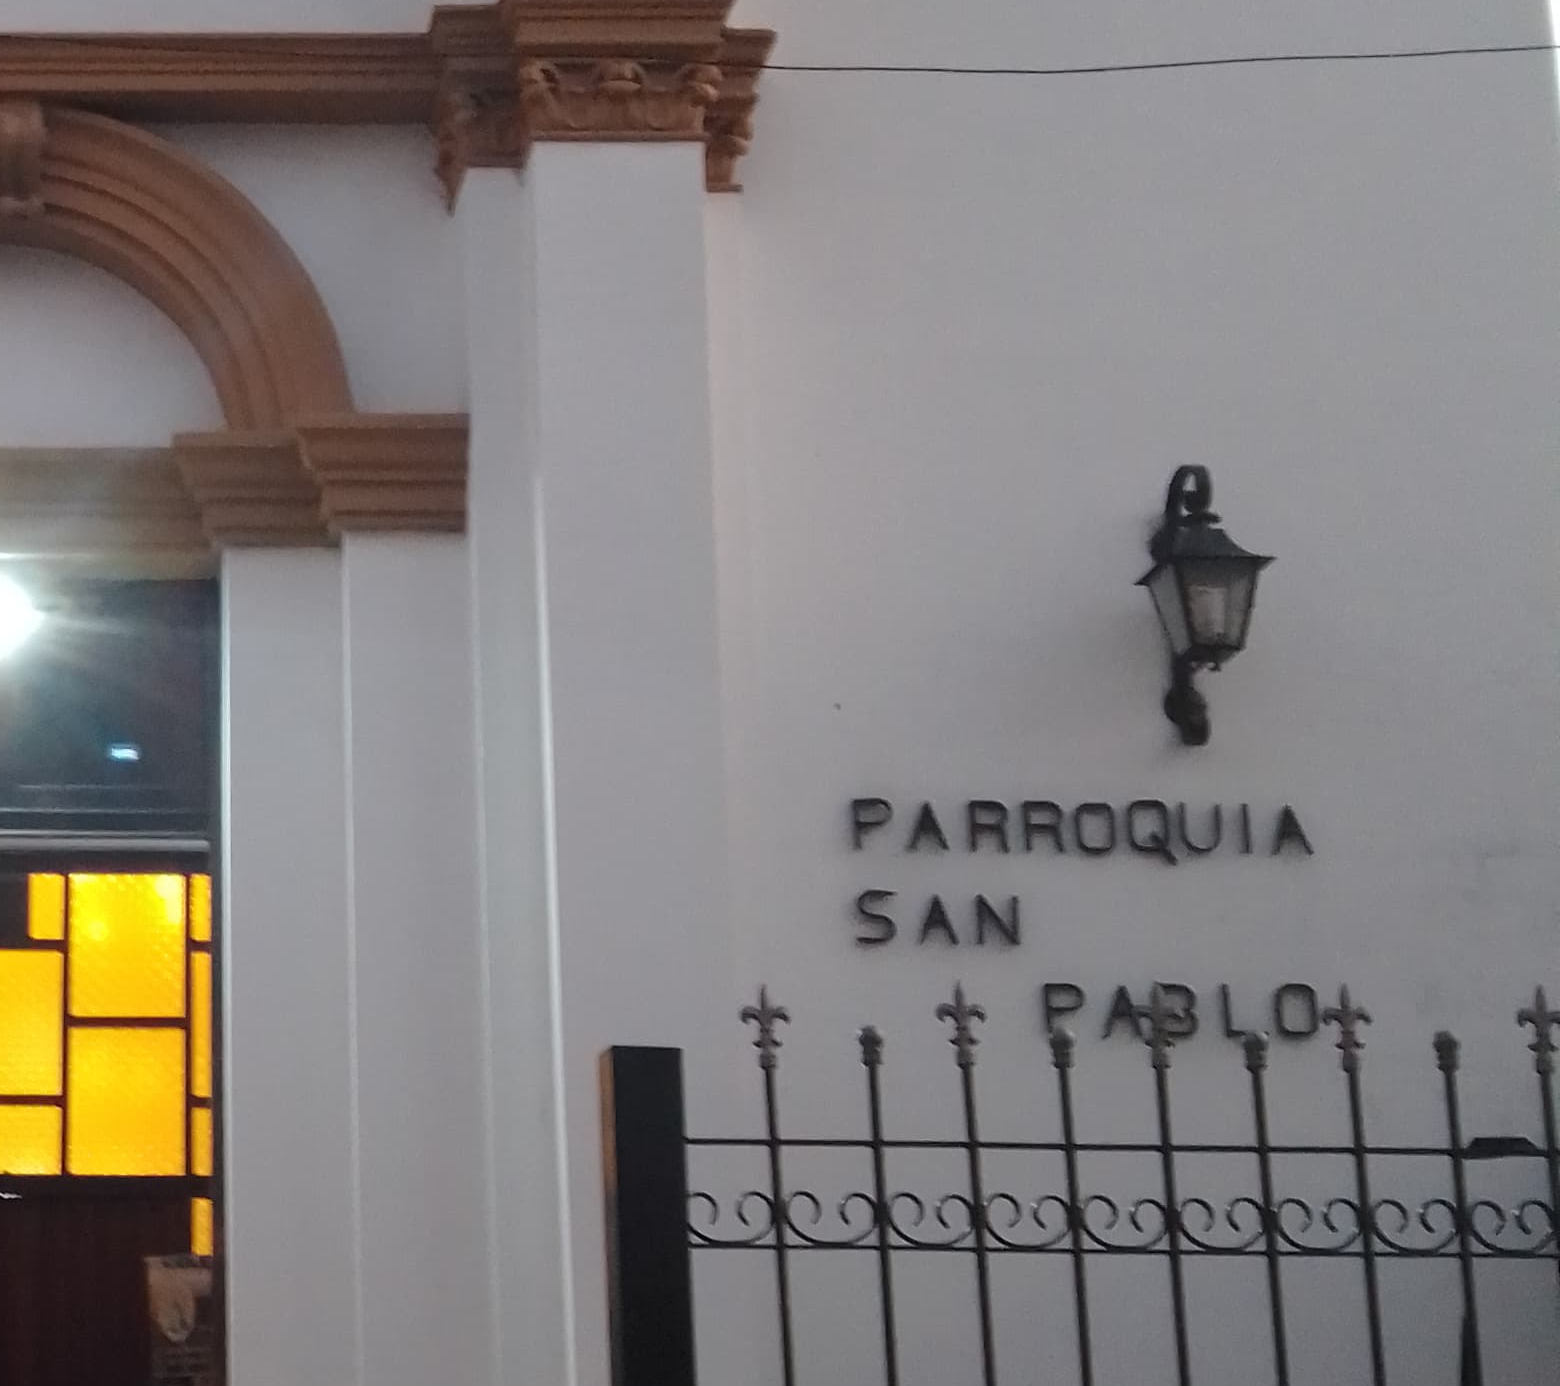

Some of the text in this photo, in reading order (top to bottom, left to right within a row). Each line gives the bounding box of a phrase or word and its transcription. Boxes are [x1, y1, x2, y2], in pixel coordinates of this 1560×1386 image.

[850, 797, 1314, 865] PARROQUIA
[855, 889, 1021, 946] SAN
[1042, 982, 1320, 1039] PABLO
